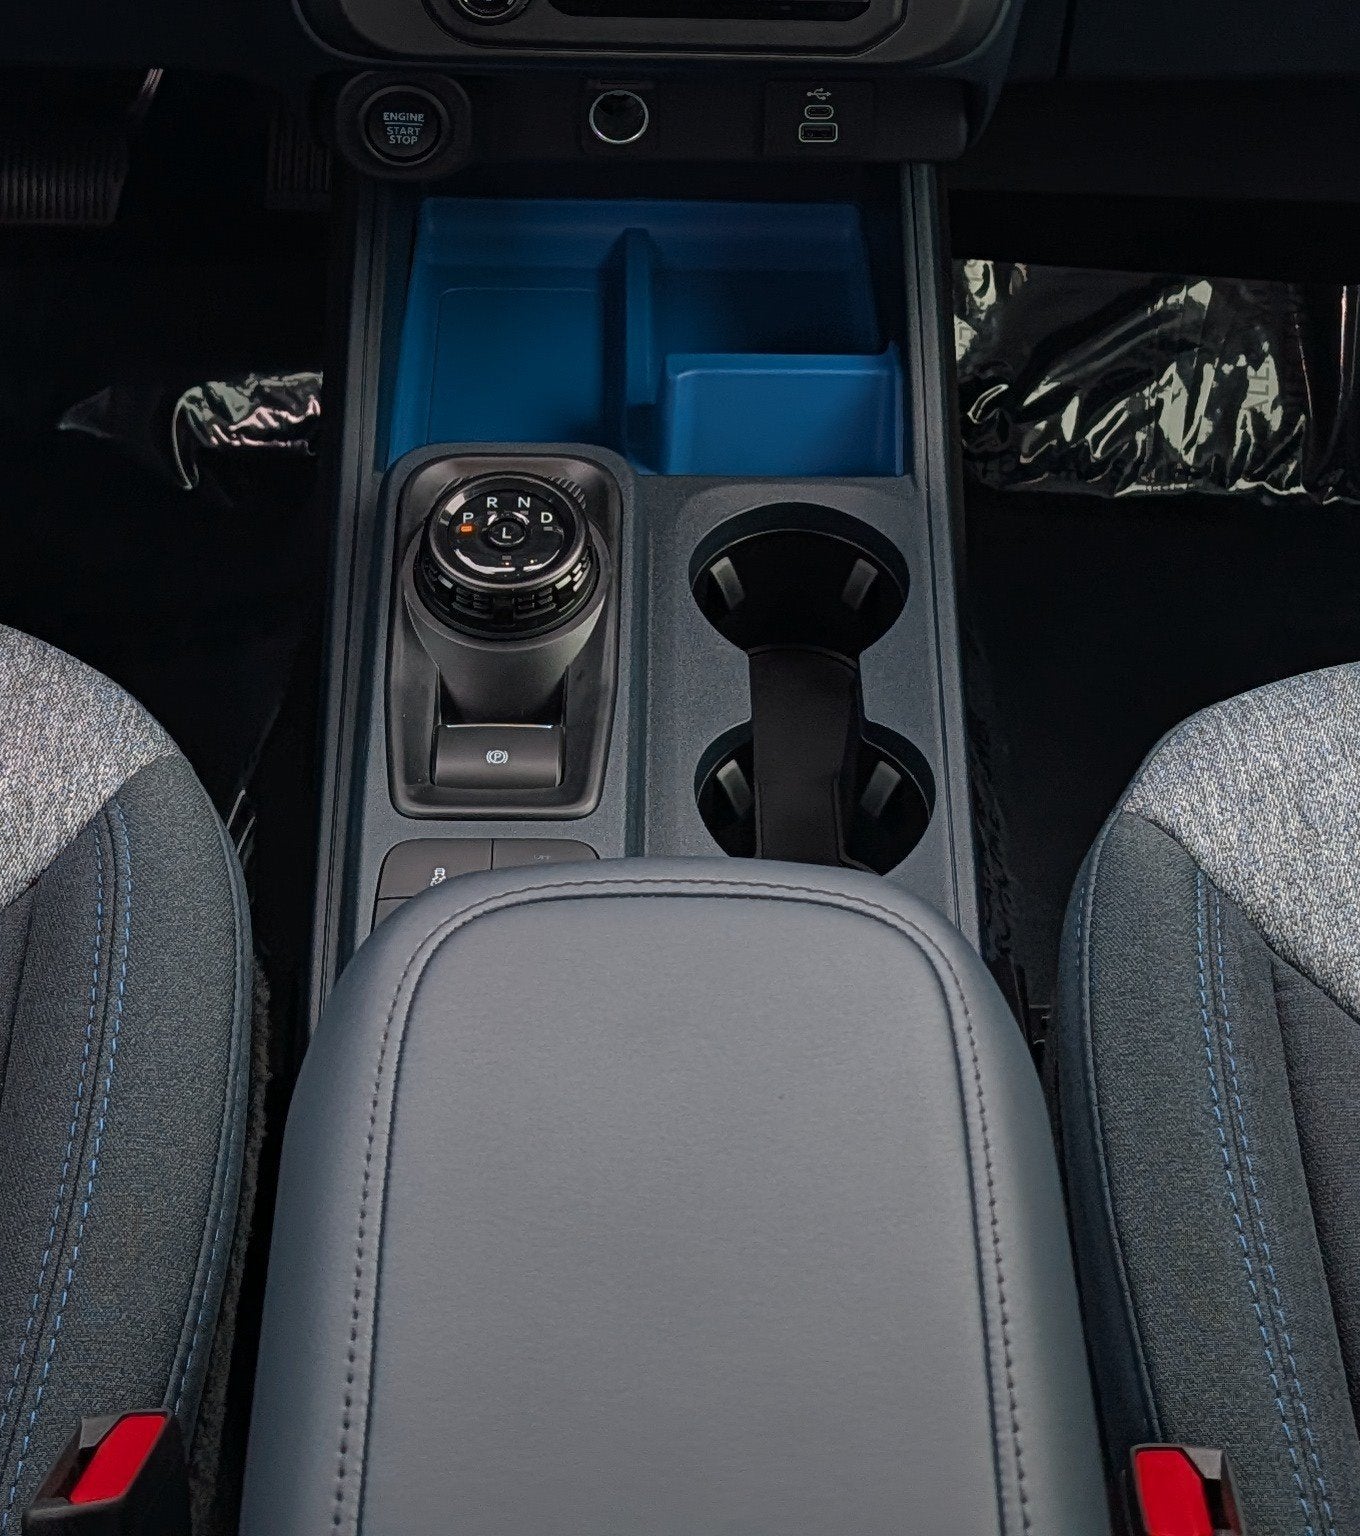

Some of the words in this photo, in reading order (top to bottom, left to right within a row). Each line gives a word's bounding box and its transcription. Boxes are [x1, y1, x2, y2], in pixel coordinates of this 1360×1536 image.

[383, 111, 425, 122] ENGINE
[386, 126, 421, 136] START
[388, 135, 418, 146] STOP
[487, 497, 498, 508] R
[518, 497, 531, 508] N
[462, 512, 474, 524] P
[541, 512, 553, 524] D
[502, 528, 512, 540] L
